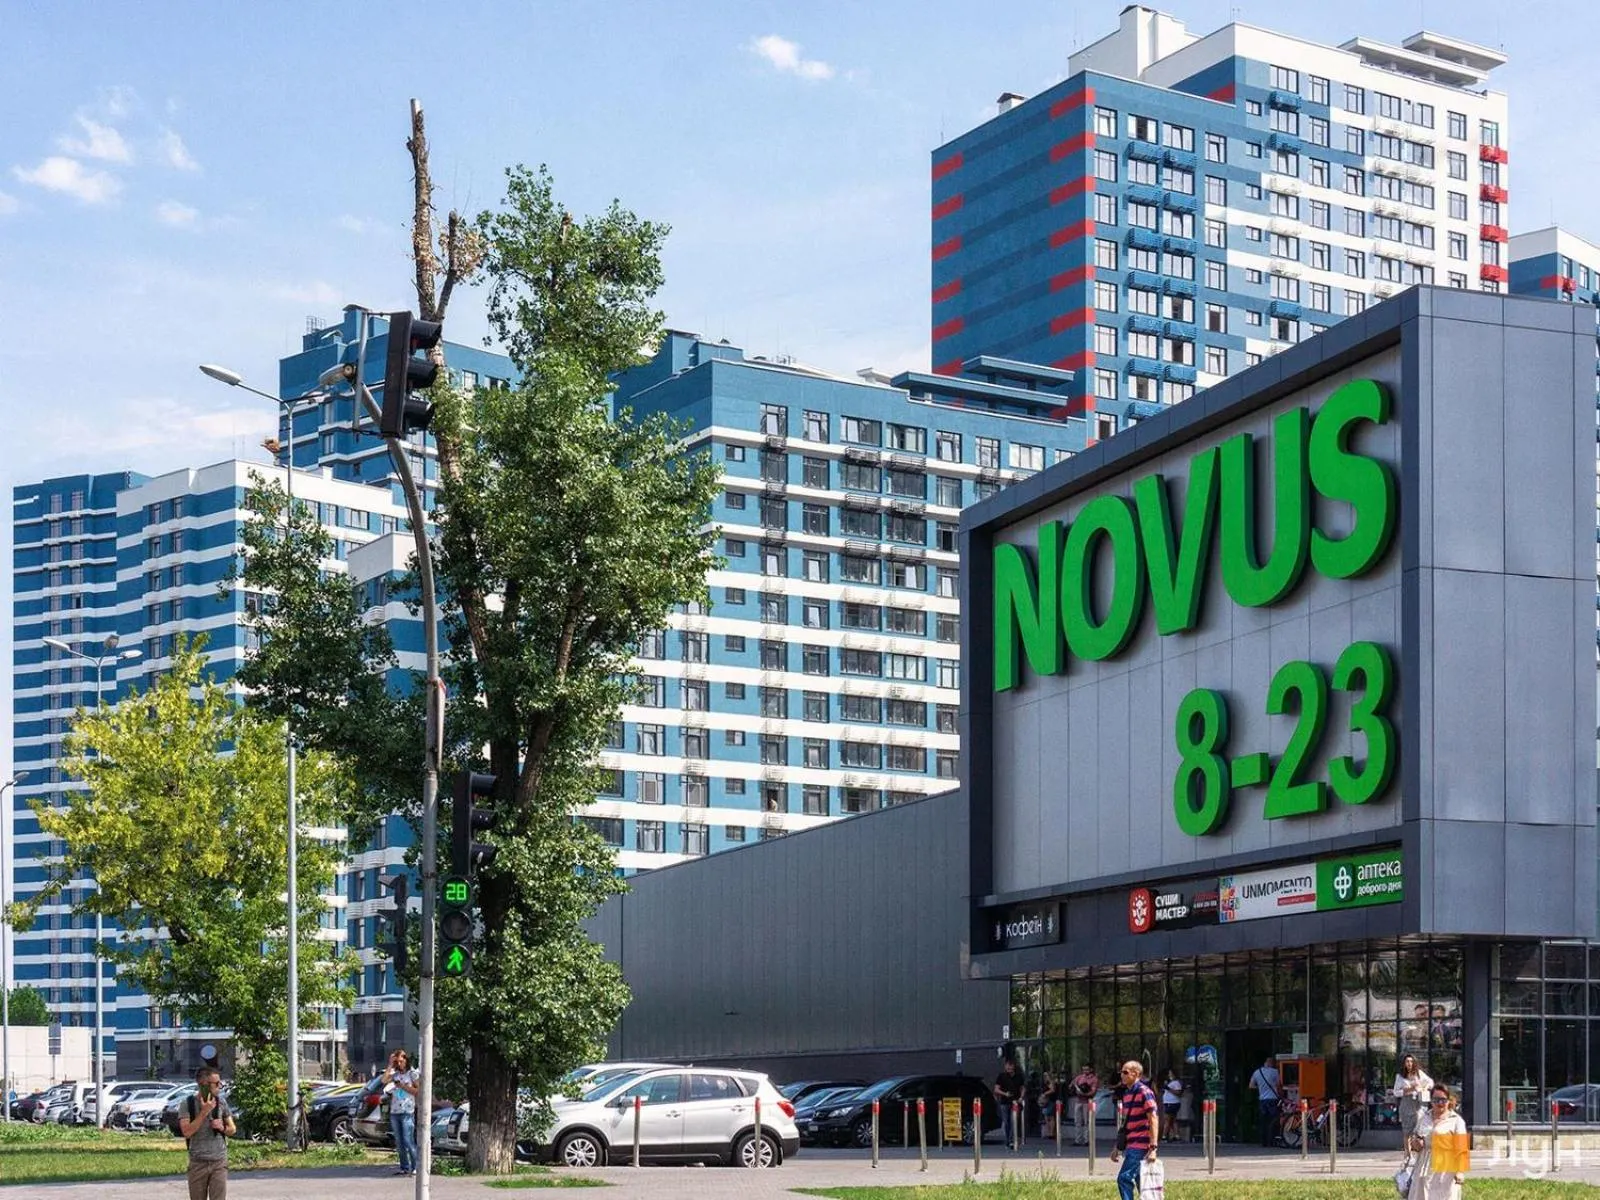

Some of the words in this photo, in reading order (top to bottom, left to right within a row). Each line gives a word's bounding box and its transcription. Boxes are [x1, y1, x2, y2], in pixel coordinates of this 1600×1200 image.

[994, 378, 1396, 692] NOVUS
[1173, 641, 1395, 837] 8-23
[1357, 860, 1401, 881] аптека
[446, 883, 467, 900] 28
[1242, 876, 1312, 899] UNMOMENTO
[1357, 882, 1388, 897] доброго
[1387, 881, 1402, 893] дня
[1155, 893, 1179, 908] СУШИ
[1155, 905, 1187, 921] МАСТЕР
[1006, 914, 1043, 940] кофеїн
